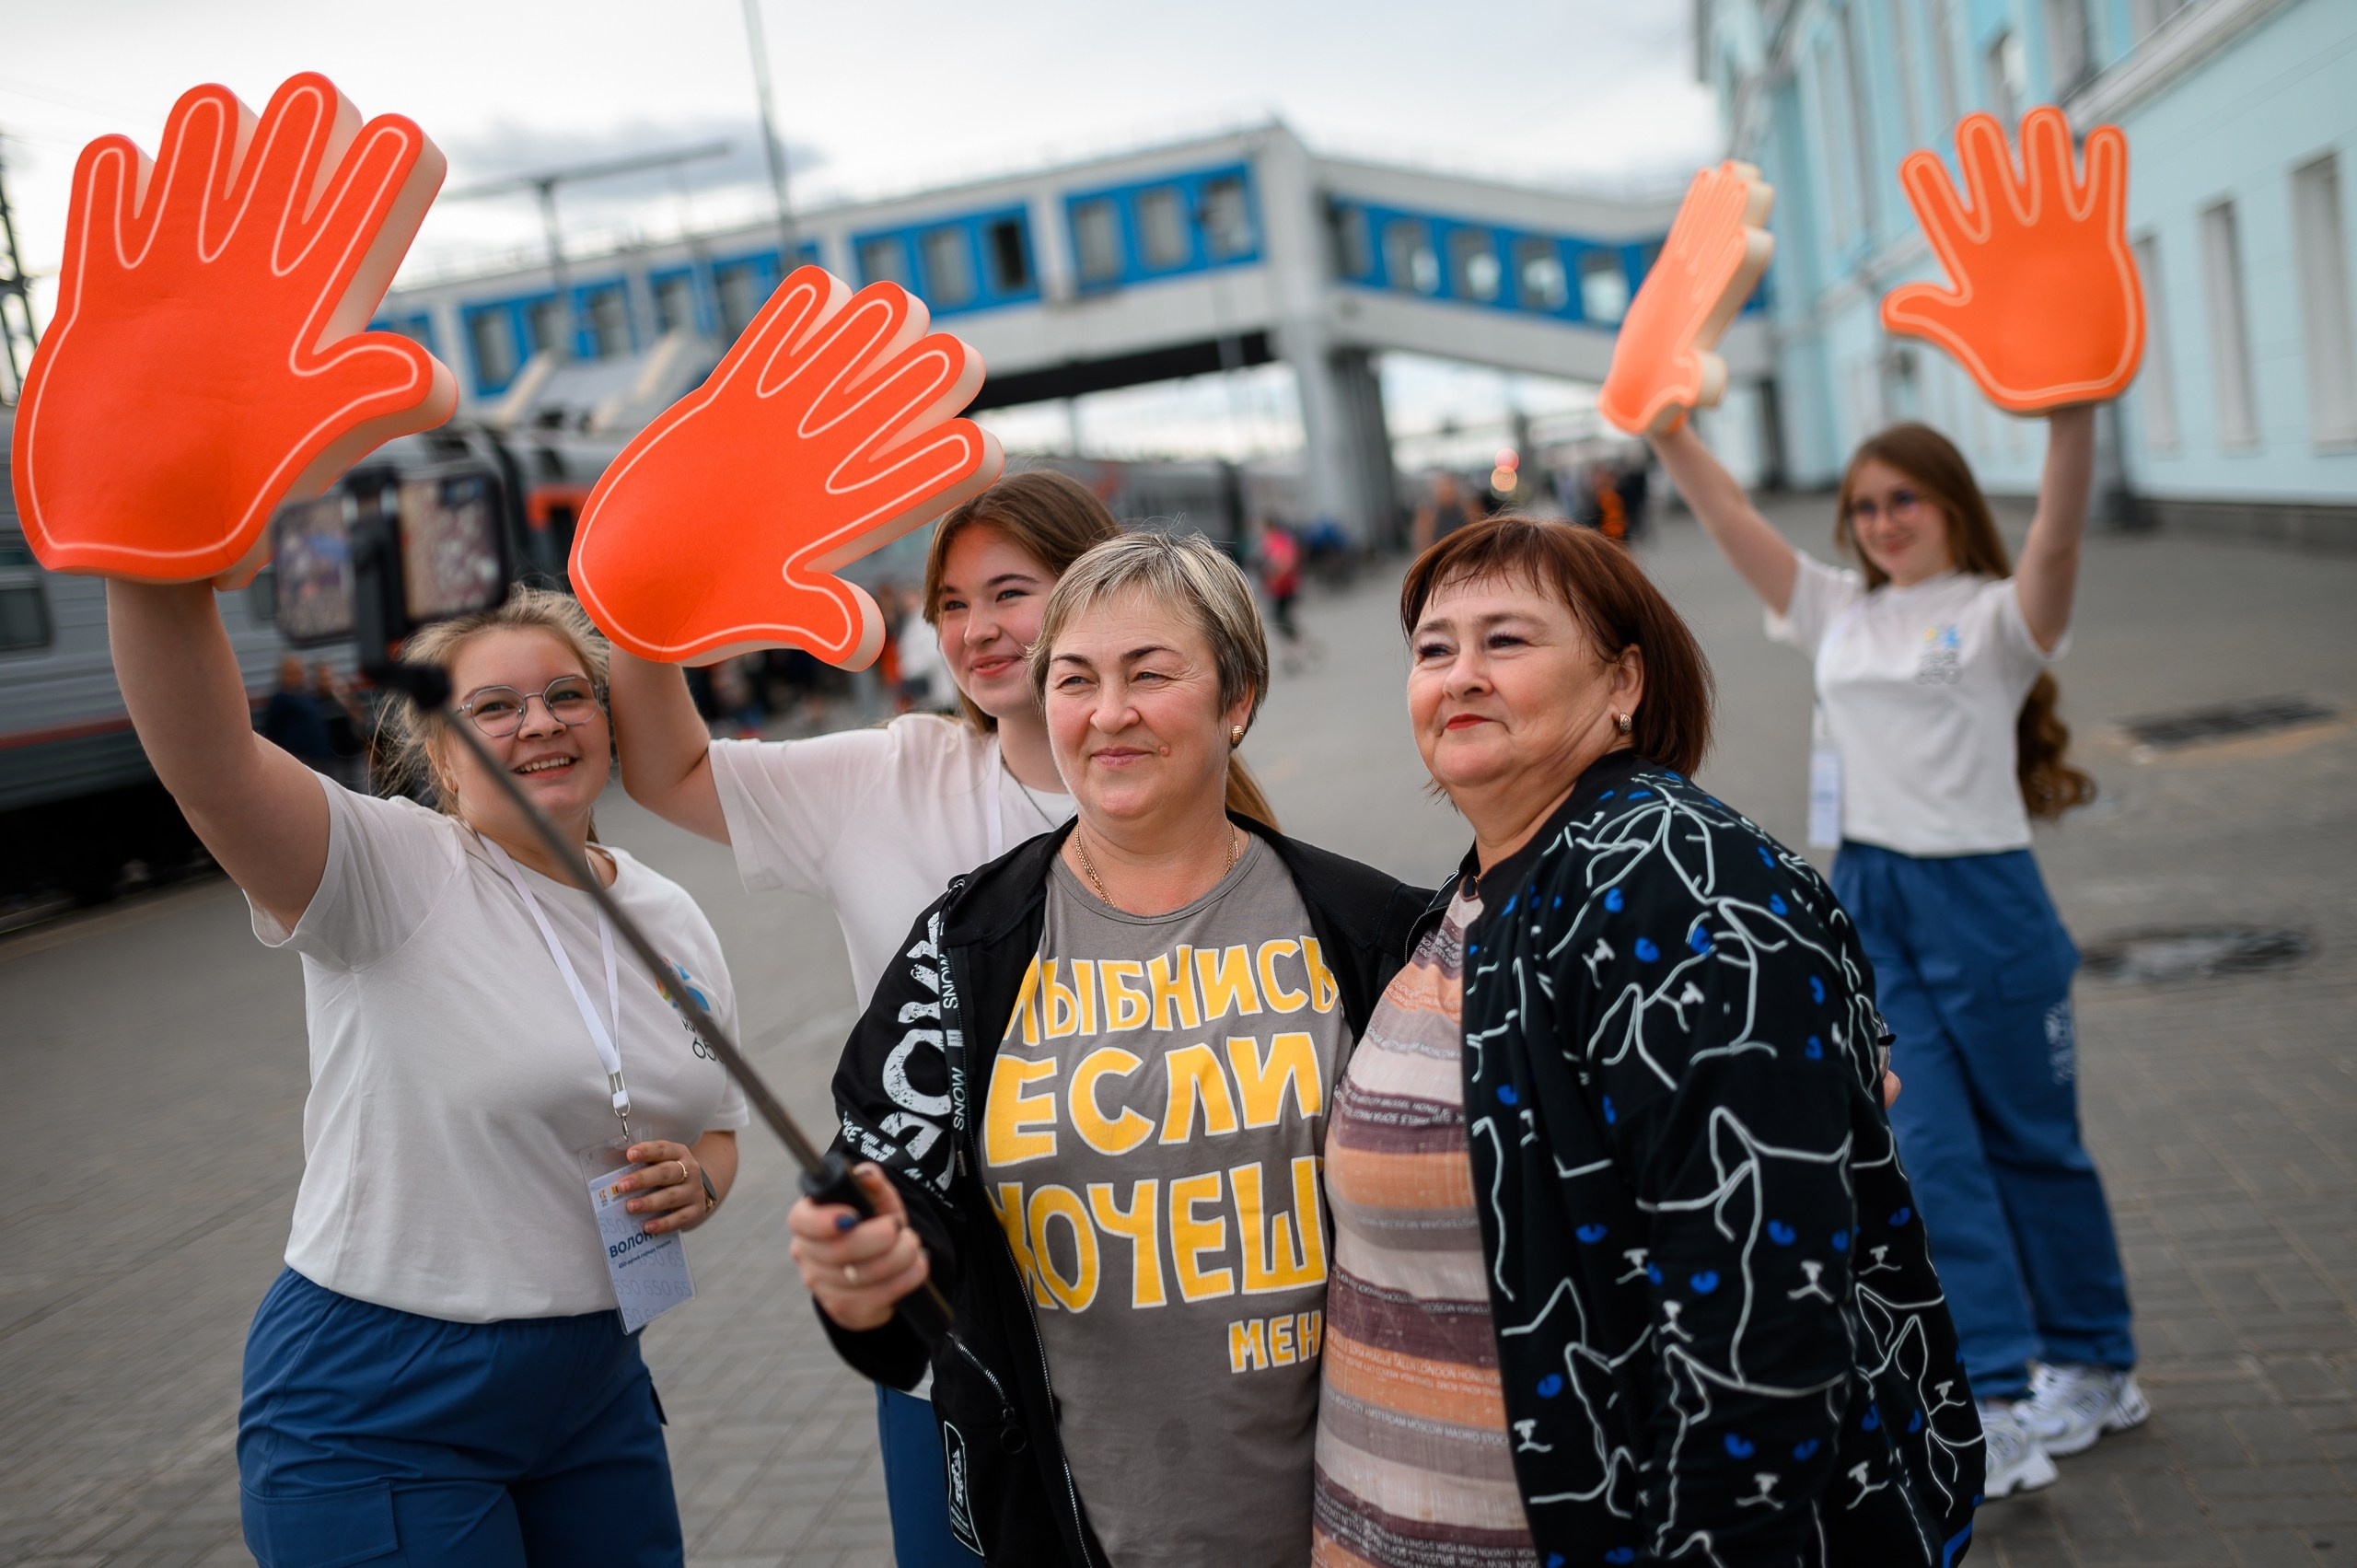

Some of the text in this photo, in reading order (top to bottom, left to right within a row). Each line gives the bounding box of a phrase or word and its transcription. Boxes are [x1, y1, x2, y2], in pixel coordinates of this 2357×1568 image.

[1004, 935, 1341, 1047] ЛЫБНИСЬ
[692, 1037, 725, 1064] 65
[951, 1067, 967, 1132] SNOW
[985, 1031, 1323, 1167] ЕСЛИ
[609, 1229, 658, 1260] ВОЛОН
[985, 1155, 1328, 1314] ХОЧЕШ
[1228, 1309, 1322, 1374] МЕН
[1364, 1405, 1407, 1427] AMSTERDAM
[1407, 1418, 1444, 1434] MOSCOW
[1445, 1426, 1480, 1442] MADRID
[1480, 1433, 1509, 1447] STOC
